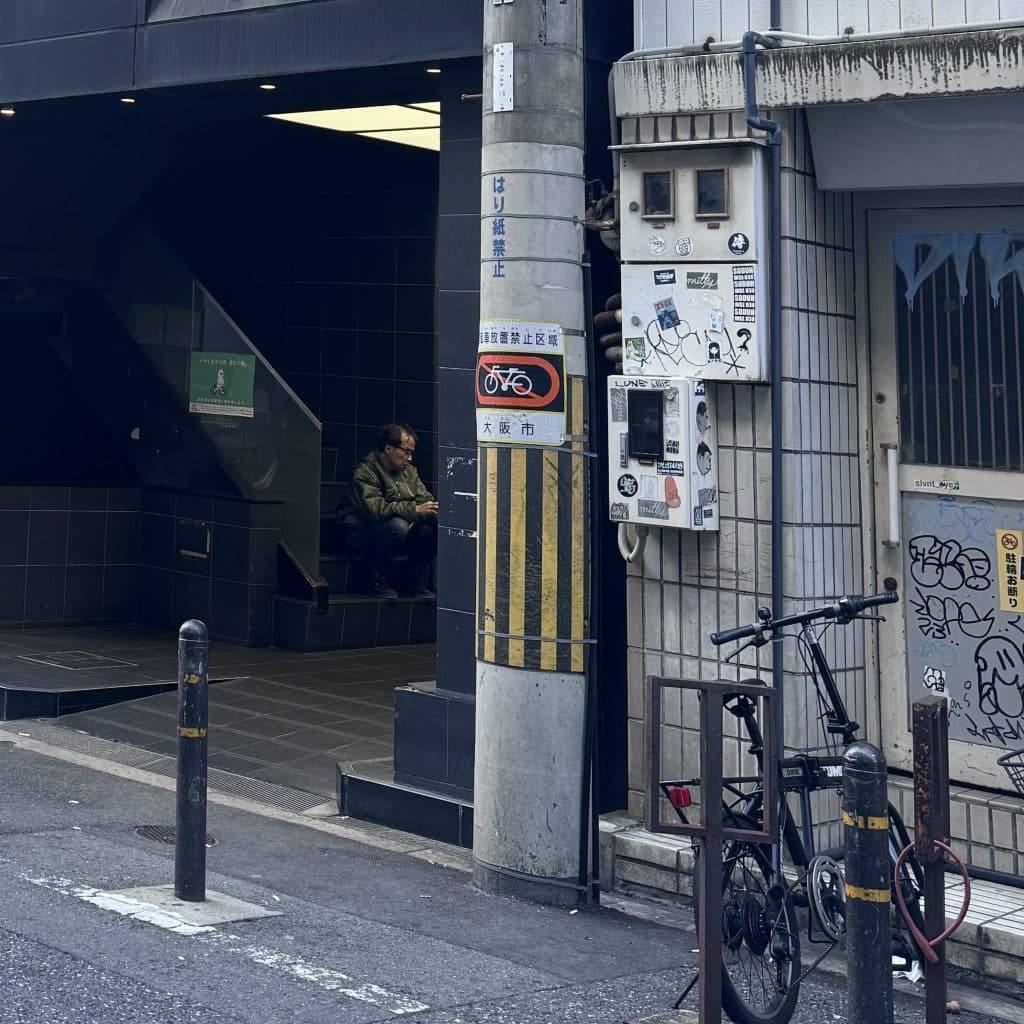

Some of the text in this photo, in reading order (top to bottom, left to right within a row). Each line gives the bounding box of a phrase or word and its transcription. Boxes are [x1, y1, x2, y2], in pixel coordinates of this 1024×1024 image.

[492, 176, 506, 279] はり紙禁止
[480, 332, 558, 346] 車放置禁止区域
[483, 421, 535, 436] 大阪市
